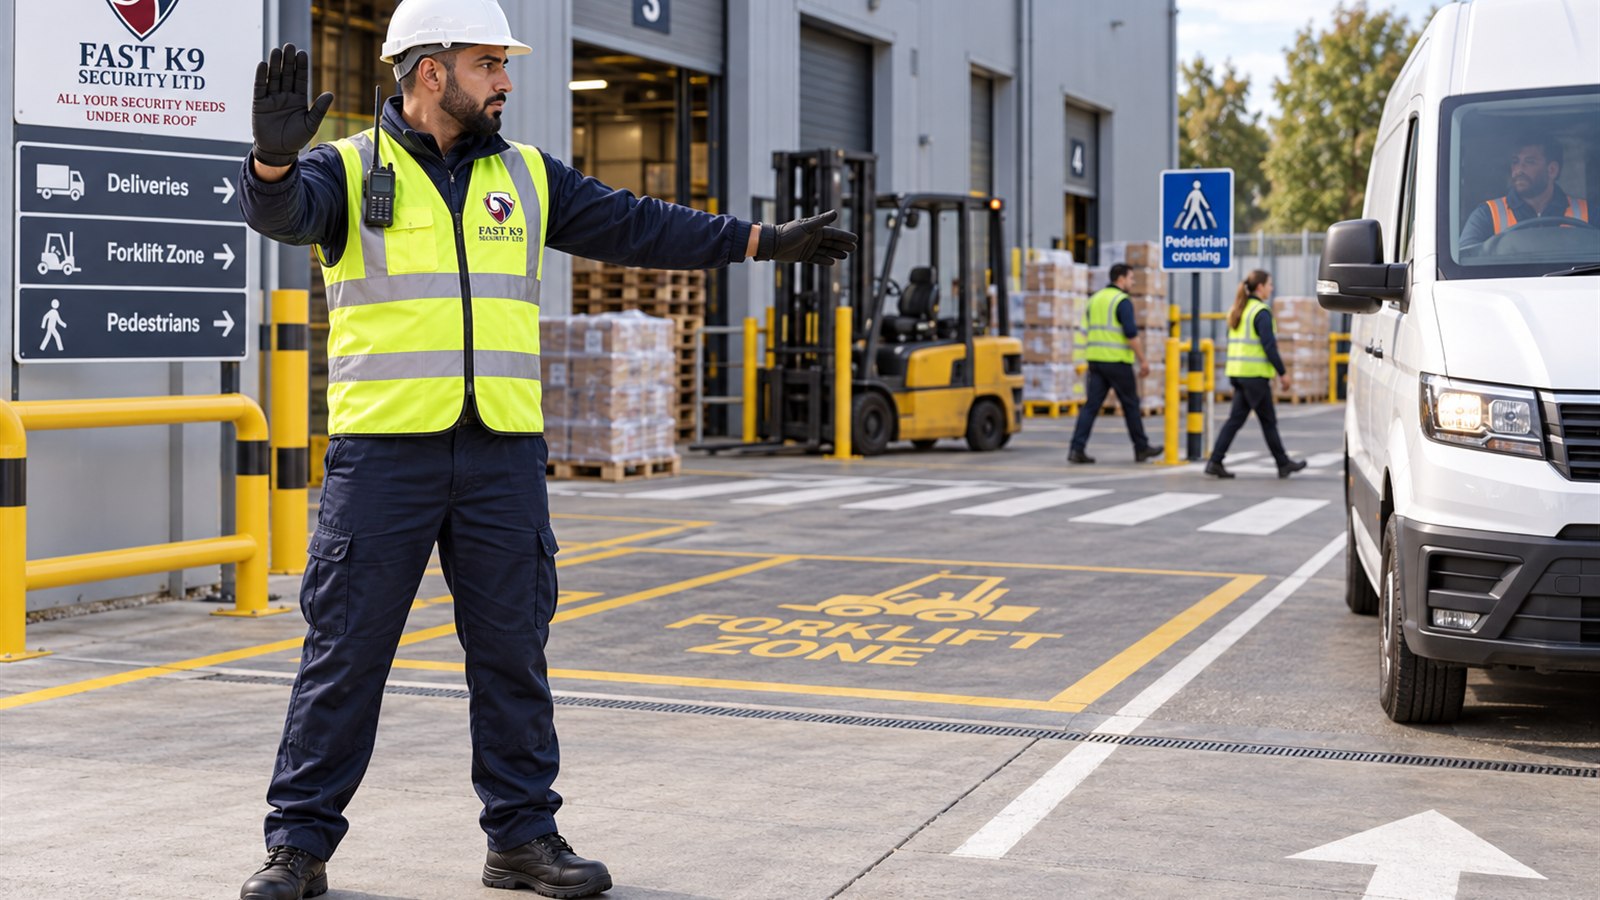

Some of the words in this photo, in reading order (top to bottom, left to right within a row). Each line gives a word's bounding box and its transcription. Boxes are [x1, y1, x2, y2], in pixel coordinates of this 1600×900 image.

[79, 42, 156, 70] FAST
[164, 47, 206, 73] K9
[78, 69, 168, 89] SECURITY
[172, 74, 206, 91] LTD
[56, 93, 81, 105] ALL
[83, 94, 119, 107] YOUR
[121, 96, 183, 111] SECURITY
[185, 100, 226, 113] NEEDS
[86, 110, 131, 123] UNDER
[132, 112, 160, 125] ONE
[162, 114, 198, 127] ROOF
[1072, 145, 1083, 174] 4
[107, 172, 190, 197] Deliveries
[479, 226, 506, 235] FAST
[509, 227, 523, 236] K9
[1165, 235, 1228, 248] Pedestrian
[107, 241, 164, 263] Forklift
[166, 244, 205, 265] Zone
[1171, 249, 1221, 265] crossing
[107, 311, 201, 333] Pedestrians
[664, 614, 1063, 650] FORKLIFT
[685, 635, 935, 667] ZONE
